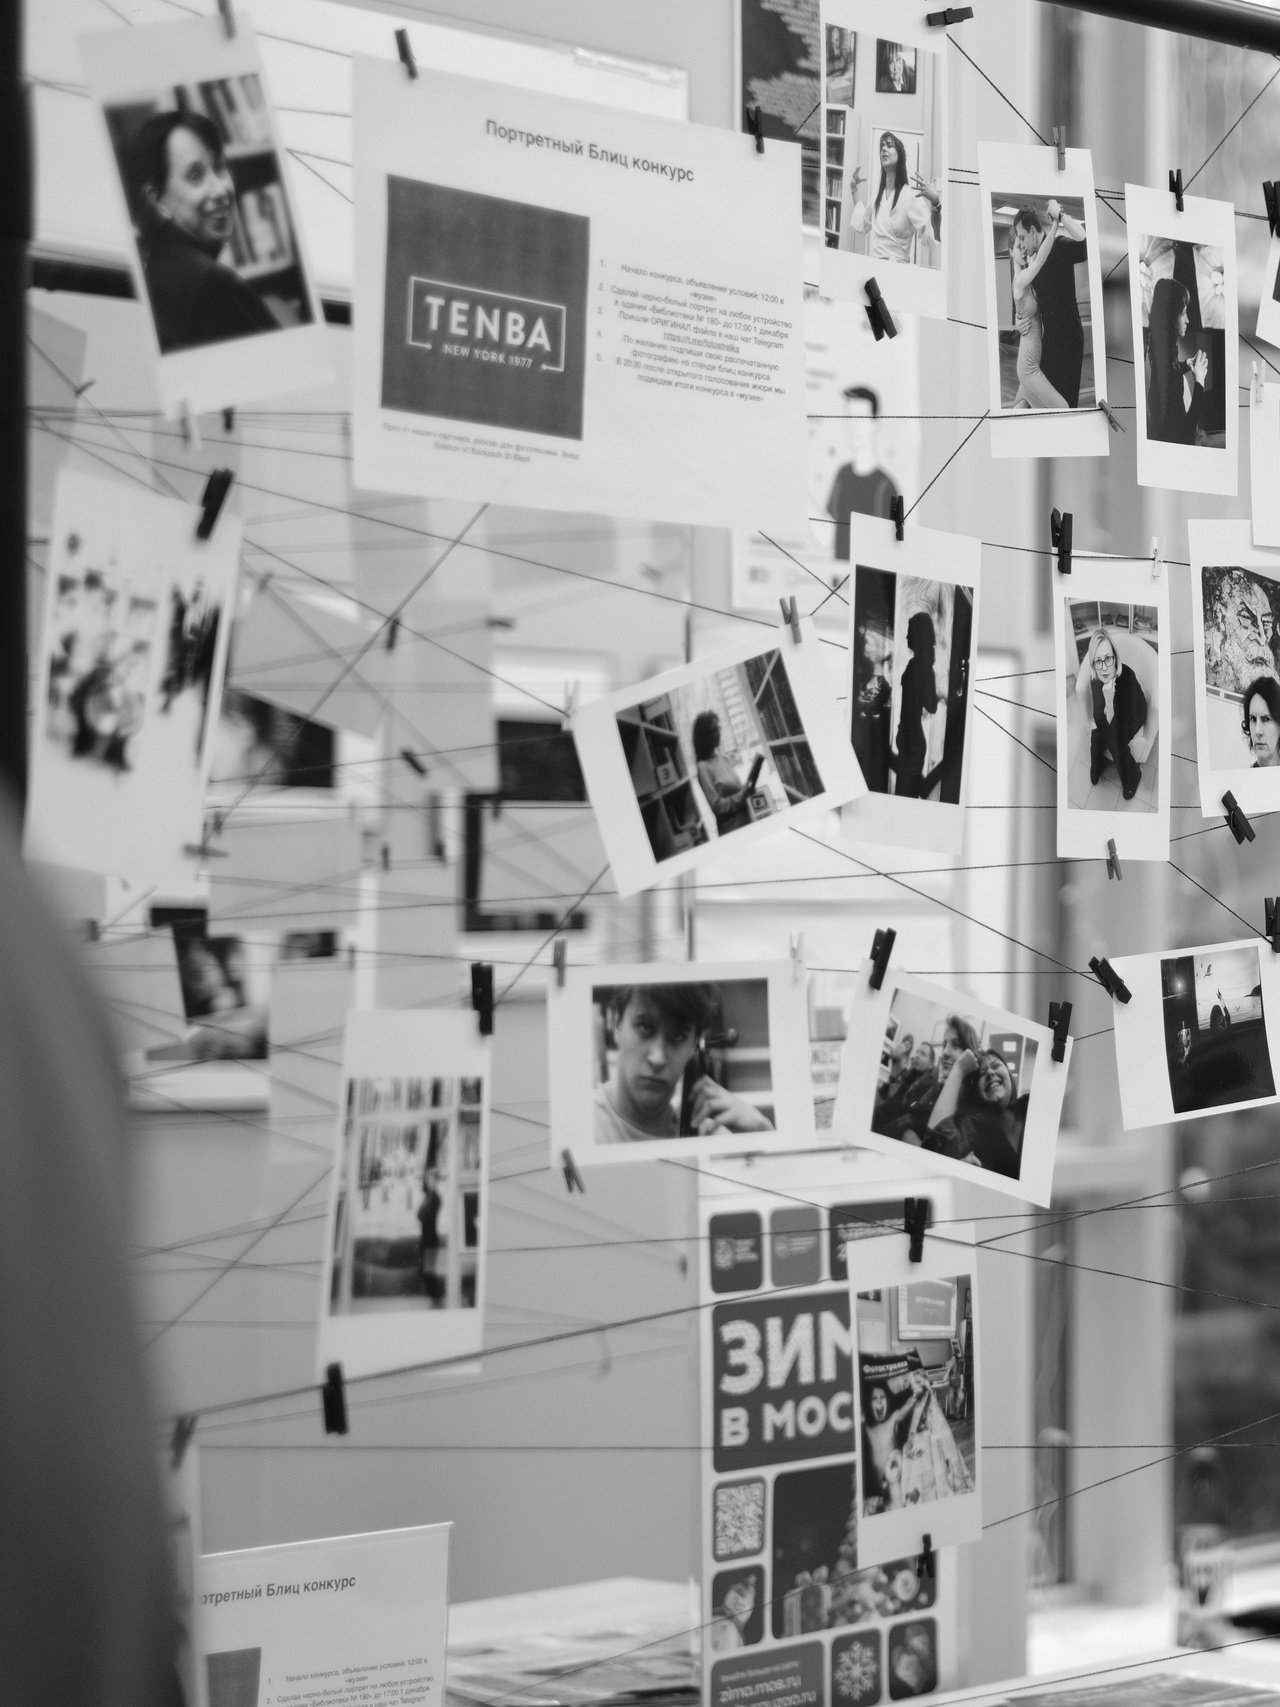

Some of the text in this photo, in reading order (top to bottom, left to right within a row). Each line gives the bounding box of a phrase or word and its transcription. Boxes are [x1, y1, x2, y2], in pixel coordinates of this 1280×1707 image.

[485, 119, 695, 182] Портретный Блиц конкурс
[621, 264, 648, 276] Начало
[685, 278, 728, 293] объявление
[761, 293, 779, 304] 12:00
[611, 285, 639, 298] Сделай
[641, 293, 688, 307] черно-белый
[689, 302, 717, 313] портрет
[719, 308, 727, 316] на
[729, 311, 751, 321] любое
[753, 315, 793, 329] устройство
[621, 301, 647, 311] здании
[723, 321, 732, 329] до
[734, 322, 752, 332] 17:00
[759, 328, 789, 340] декабря
[425, 295, 552, 352] TENBA
[619, 310, 649, 322] Пришли
[651, 316, 691, 331] ОРИГИНАЛ
[692, 325, 717, 337] файла
[724, 333, 739, 341] наш
[754, 336, 784, 349] Telegram
[443, 343, 533, 369] NEW YORK 1977
[631, 349, 680, 364] фотографию
[691, 361, 716, 372] стенде
[718, 364, 736, 376] блиц
[737, 369, 771, 381] конкурса
[635, 339, 669, 350] желанию
[670, 345, 703, 357] подпиши
[705, 352, 723, 361] свою
[724, 356, 779, 371] распечатанную
[644, 363, 665, 373] после
[666, 368, 703, 381] открытого
[704, 375, 750, 388] голосования
[751, 383, 773, 393] жюри
[774, 387, 786, 395] мы
[674, 381, 694, 390] итоги
[696, 384, 729, 397] конкурса
[719, 1310, 852, 1396] ЗИМ
[720, 1390, 854, 1447] В МОС
[202, 1576, 356, 1606] третный Блиц конкурс
[286, 1674, 309, 1682] Начало
[408, 1657, 423, 1666] 12:00
[277, 1693, 301, 1703] Сделай
[344, 1684, 369, 1693] портрет
[379, 1680, 399, 1689] любое
[400, 1676, 434, 1687] устройство
[373, 1692, 382, 1700] до
[384, 1689, 399, 1697] 17:00
[404, 1685, 430, 1695] декабря
[400, 1695, 426, 1704] Telegram
